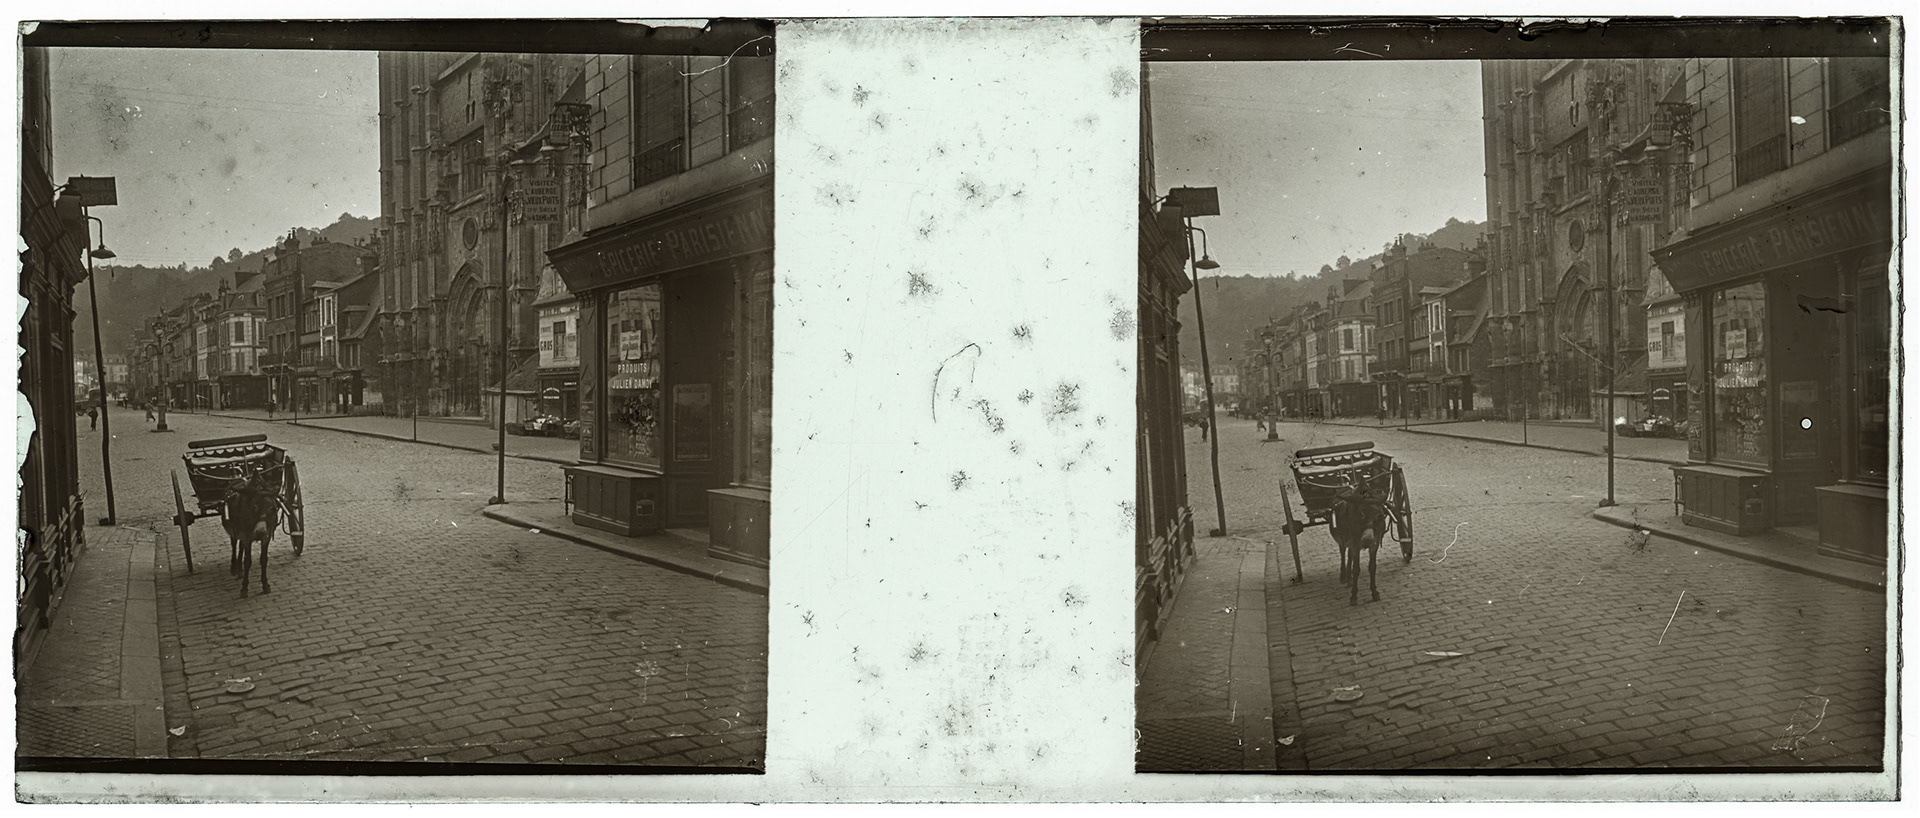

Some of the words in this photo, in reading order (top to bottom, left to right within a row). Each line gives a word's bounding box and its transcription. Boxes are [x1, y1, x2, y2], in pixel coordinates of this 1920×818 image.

[525, 187, 557, 195] L'AUBERGE
[542, 196, 560, 205] PUITS
[600, 240, 658, 277] EPICERIE
[1701, 237, 1762, 276] EPICERIE
[540, 340, 553, 351] GROS
[1649, 341, 1662, 352] GROS
[617, 362, 647, 374] PRODUITS
[634, 378, 652, 389] DAMOY
